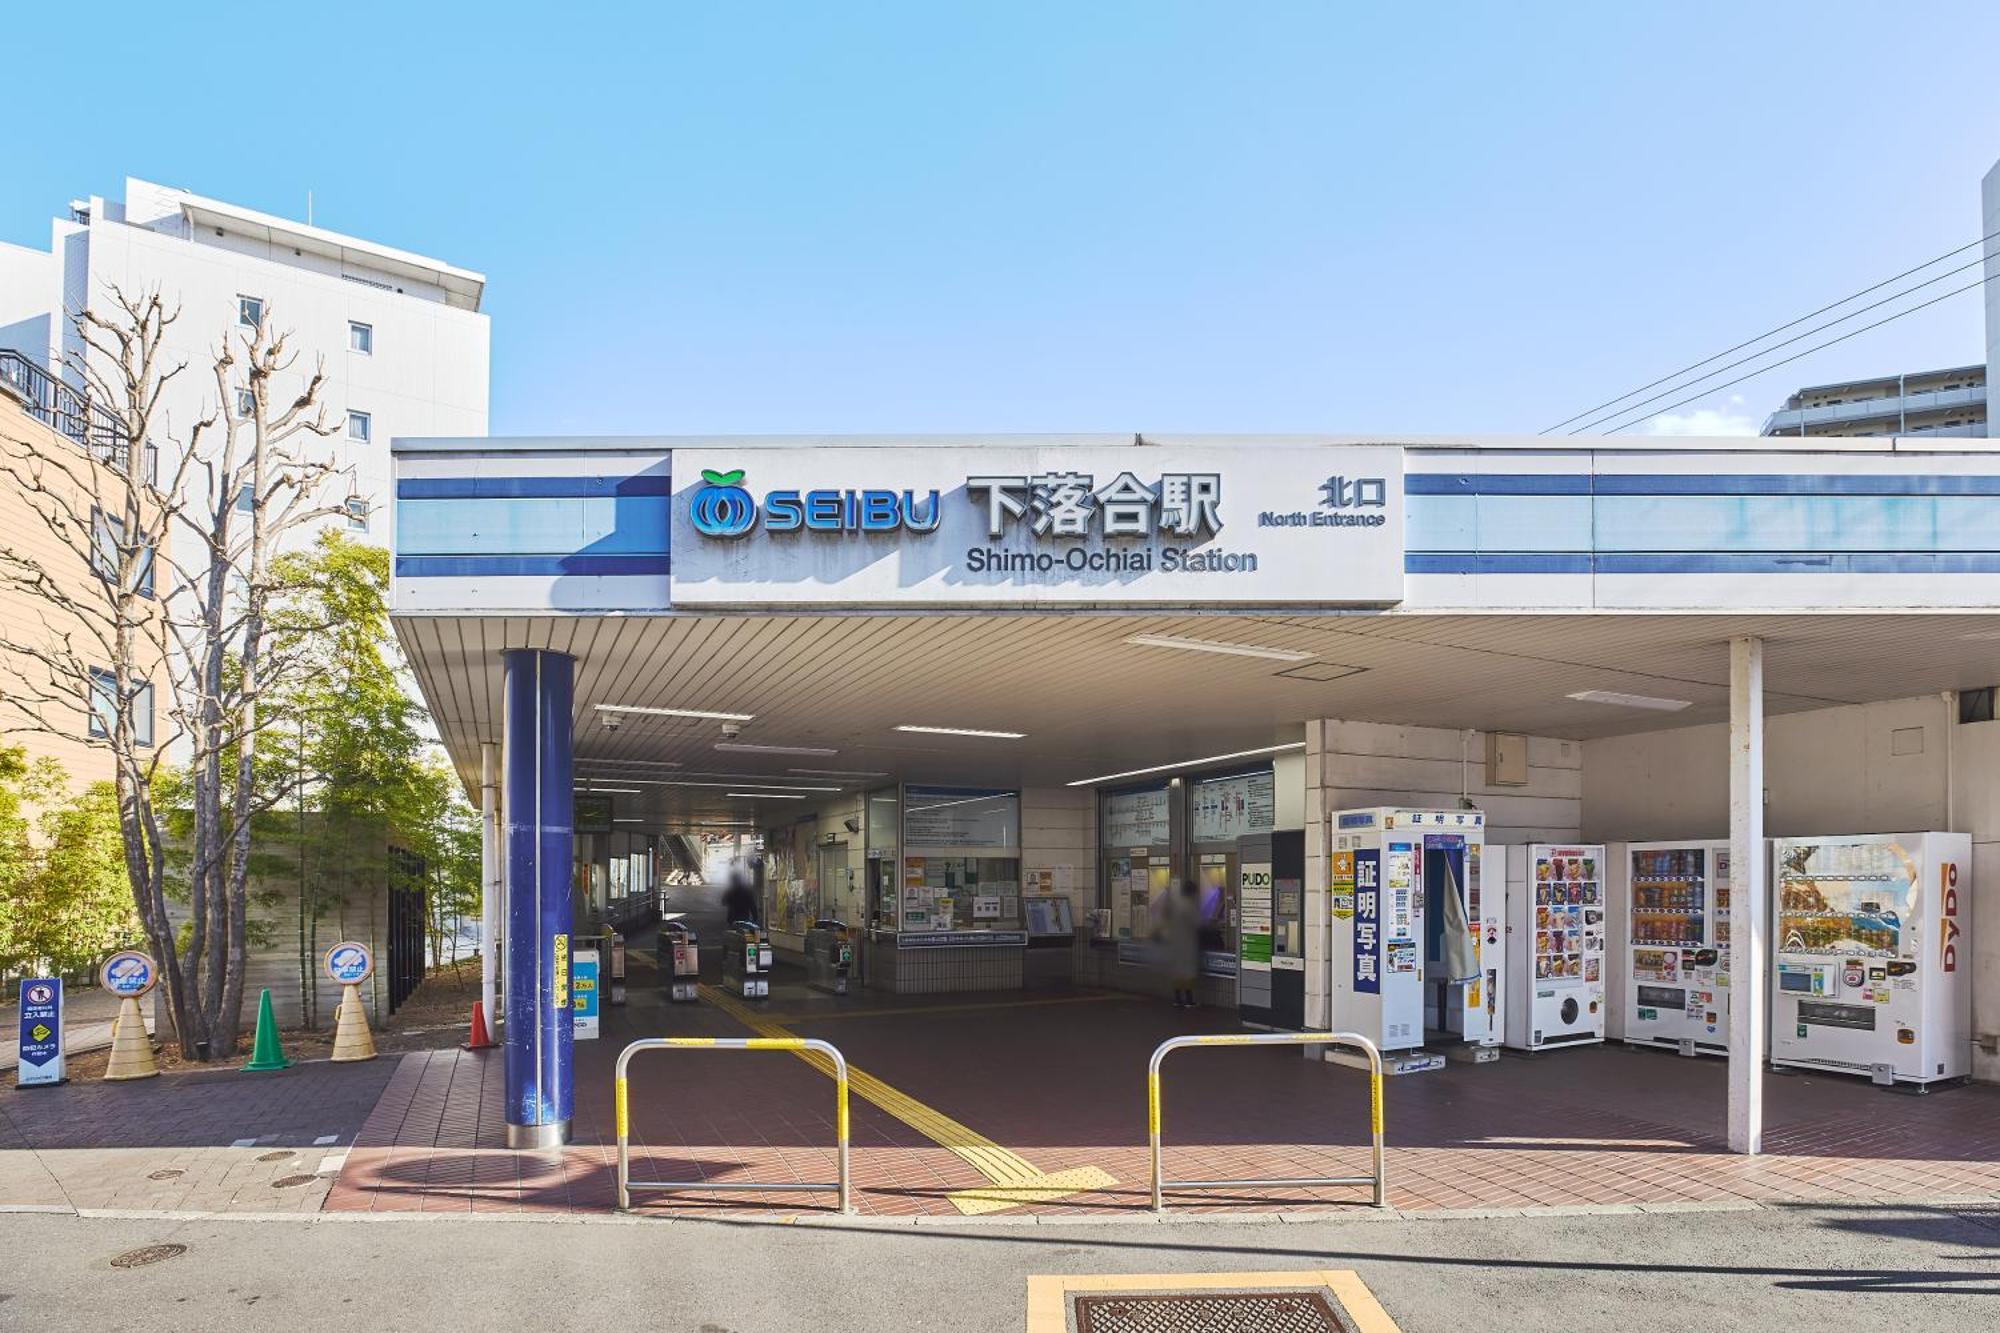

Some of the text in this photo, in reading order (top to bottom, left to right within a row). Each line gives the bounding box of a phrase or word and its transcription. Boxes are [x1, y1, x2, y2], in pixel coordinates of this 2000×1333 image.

[967, 471, 1224, 538] 下落合駅
[1317, 476, 1386, 508] 北口
[765, 489, 941, 534] SEIBU
[1258, 511, 1386, 527] North Entrance
[966, 547, 1258, 572] Shimo-Ochiai Station
[1412, 814, 1482, 824] 証明写真
[1242, 873, 1270, 886] PUDO
[1357, 860, 1377, 982] 証明写真
